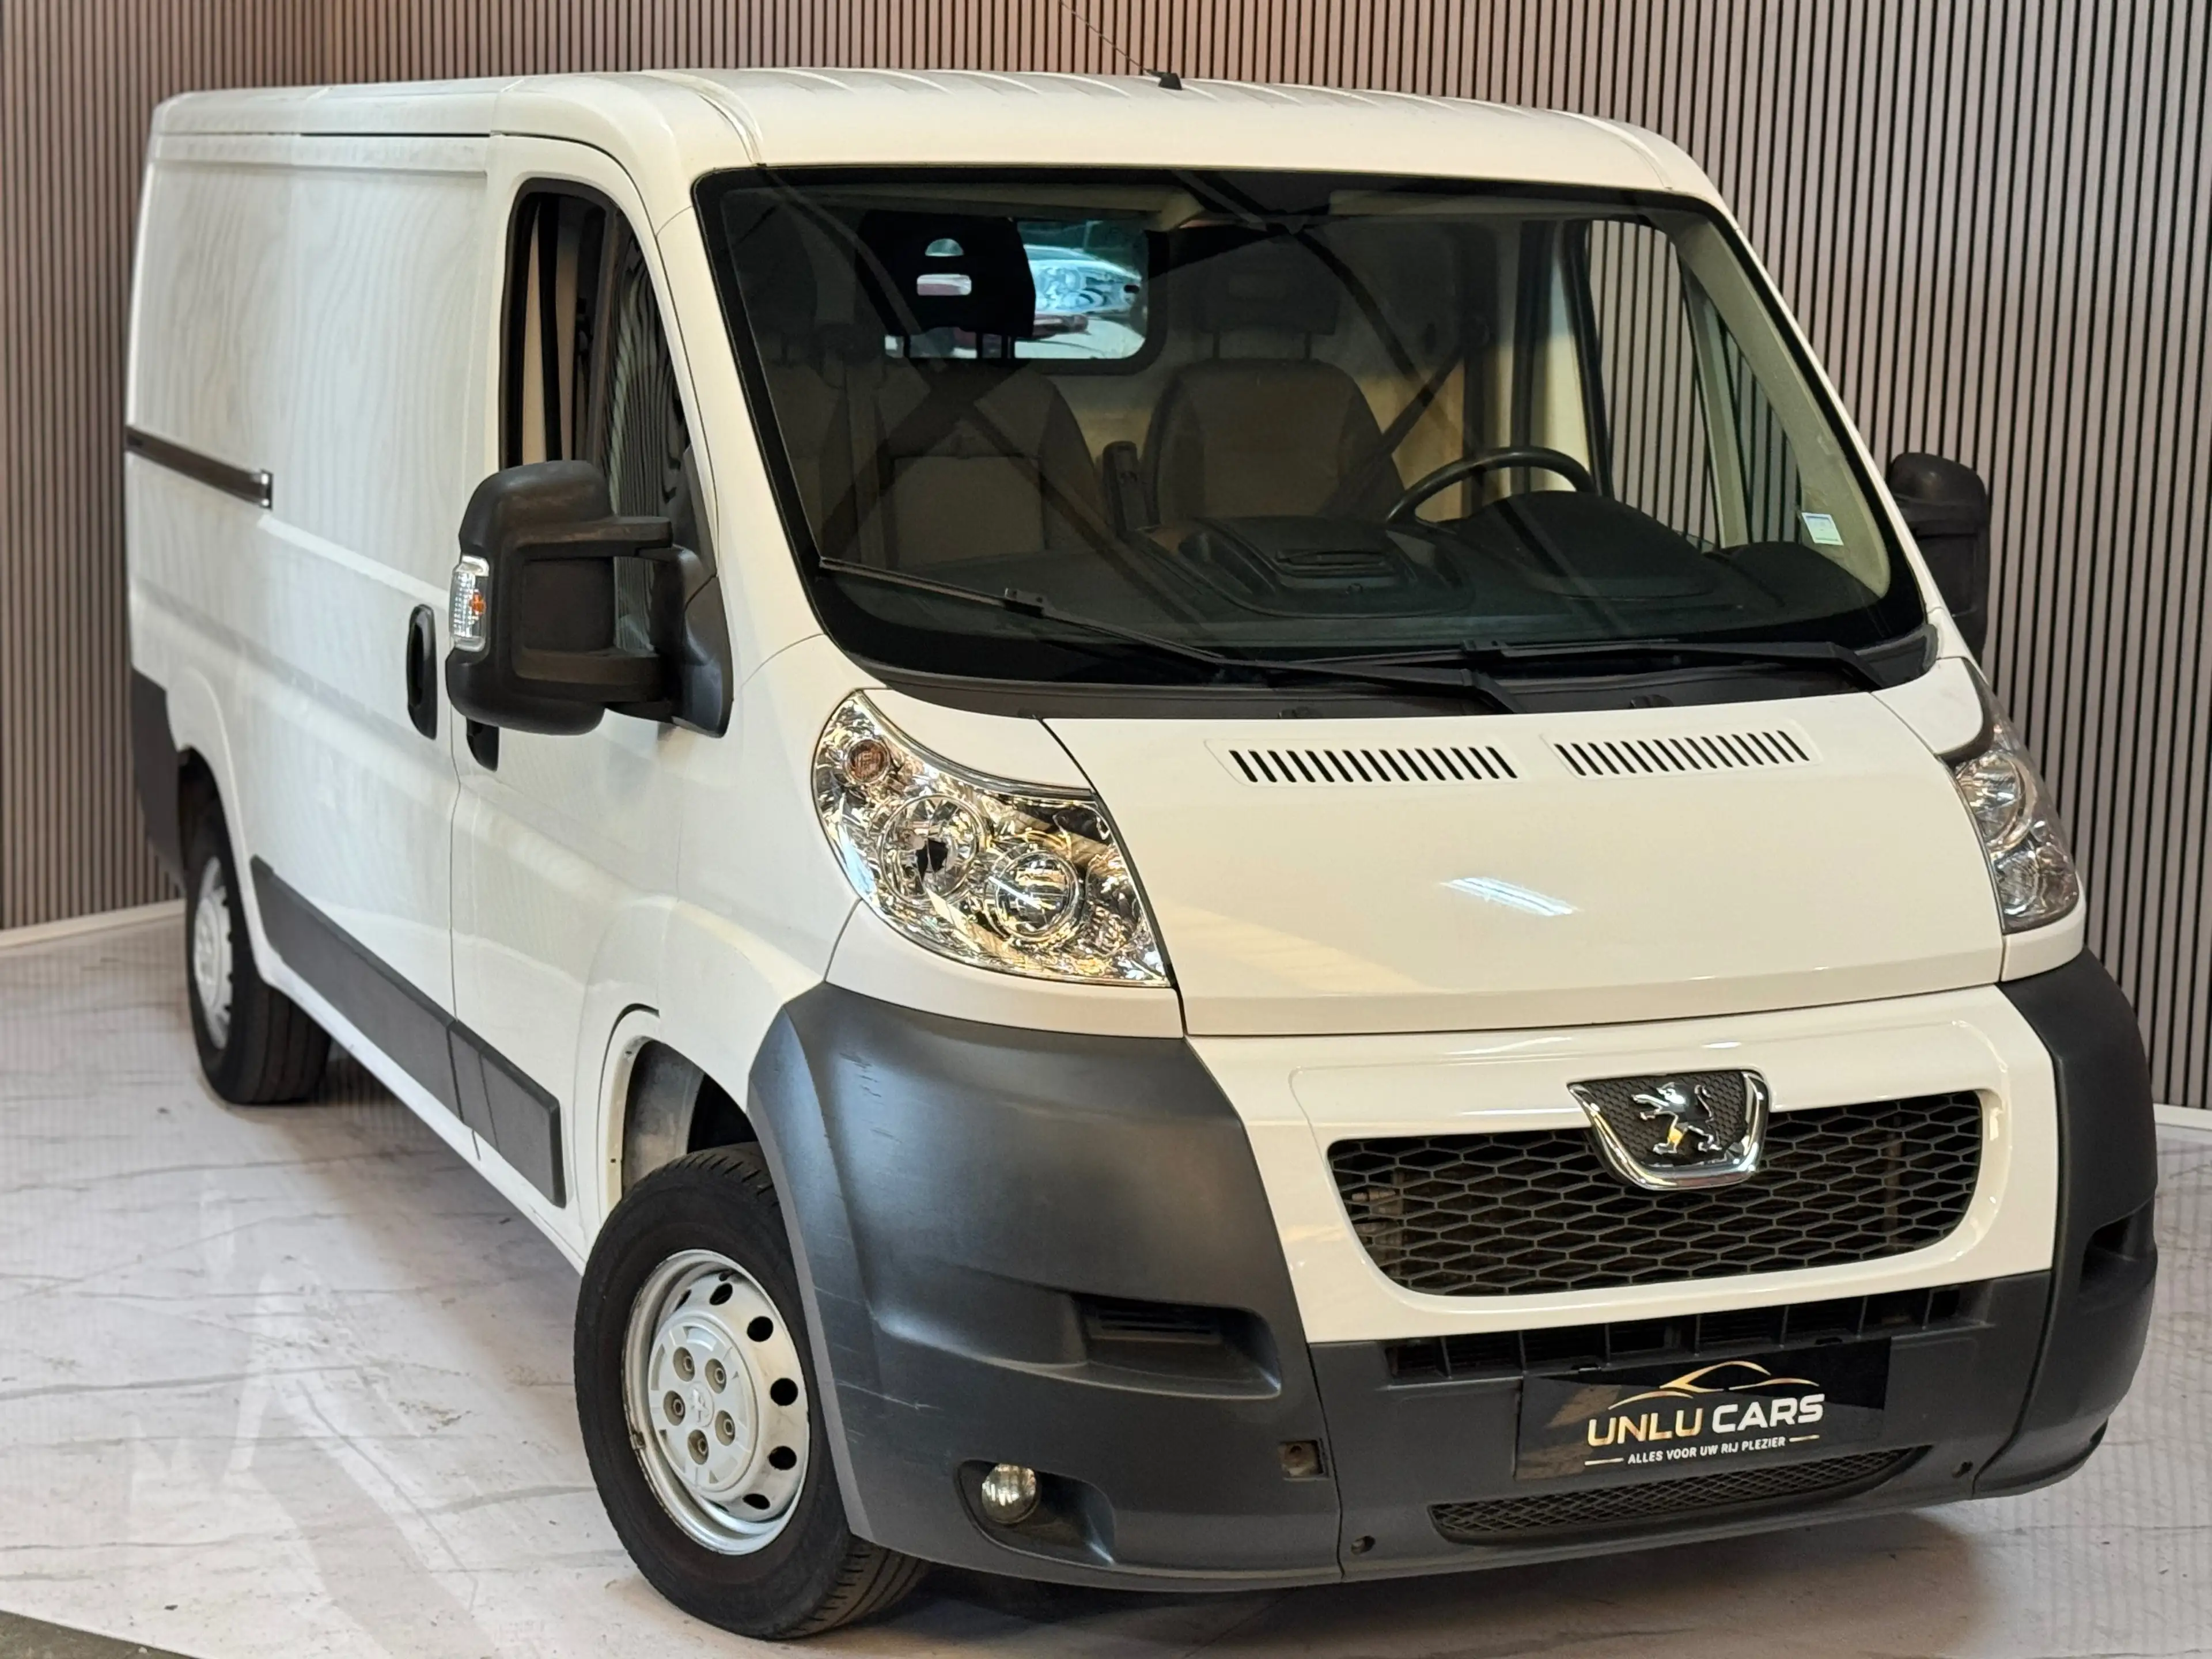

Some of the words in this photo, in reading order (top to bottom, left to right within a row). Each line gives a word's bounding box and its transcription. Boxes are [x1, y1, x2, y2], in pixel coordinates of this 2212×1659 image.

[1588, 1408, 1703, 1446] UNLU
[1713, 1394, 1825, 1433] CARS
[1628, 1451, 1662, 1464] ALLES
[1667, 1448, 1696, 1460] VOOR
[1700, 1445, 1718, 1457] UW
[1721, 1441, 1738, 1454] RIJ
[1742, 1437, 1786, 1452] PLEZIER
